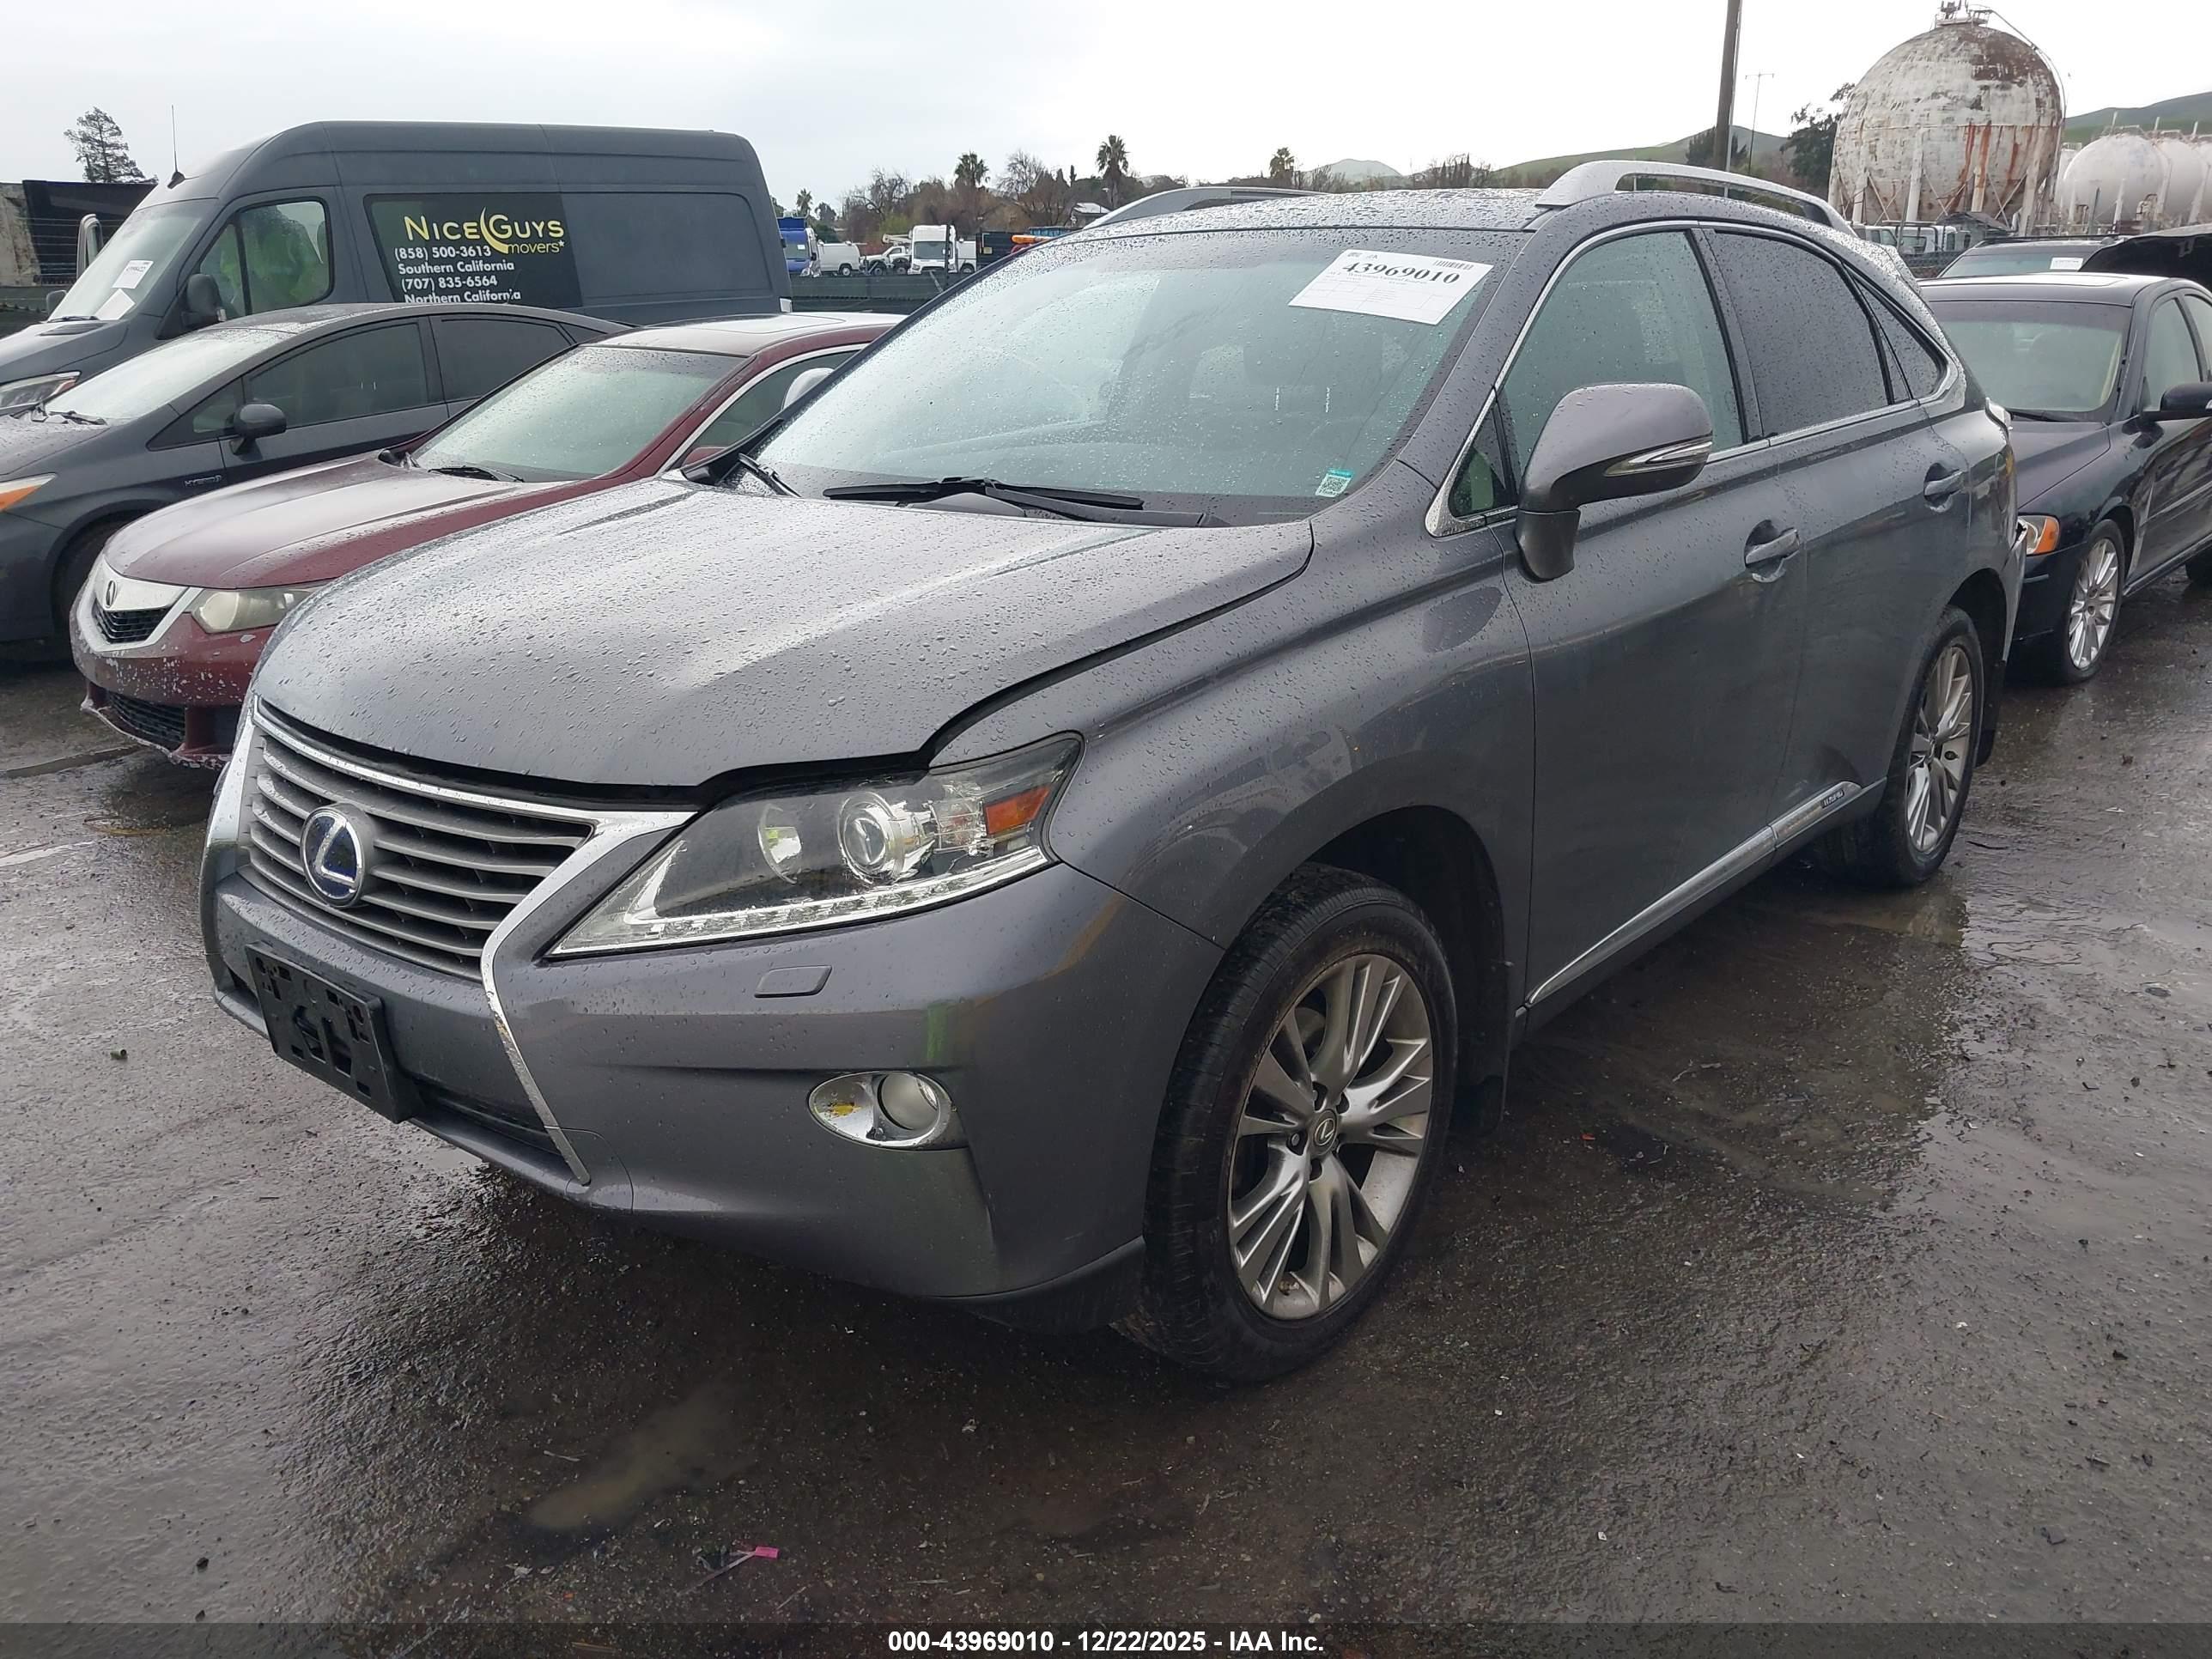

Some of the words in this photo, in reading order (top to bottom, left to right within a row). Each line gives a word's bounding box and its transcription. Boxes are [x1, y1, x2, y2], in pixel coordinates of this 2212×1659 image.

[394, 246, 428, 262] (858)
[432, 246, 492, 258] 500-3613
[508, 242, 560, 255] movers
[398, 263, 454, 275] Southern
[457, 259, 515, 273] California
[1342, 261, 1461, 284] 43969010
[401, 277, 434, 293] (707)
[438, 275, 498, 289] 835-6564
[404, 292, 460, 302] Northern
